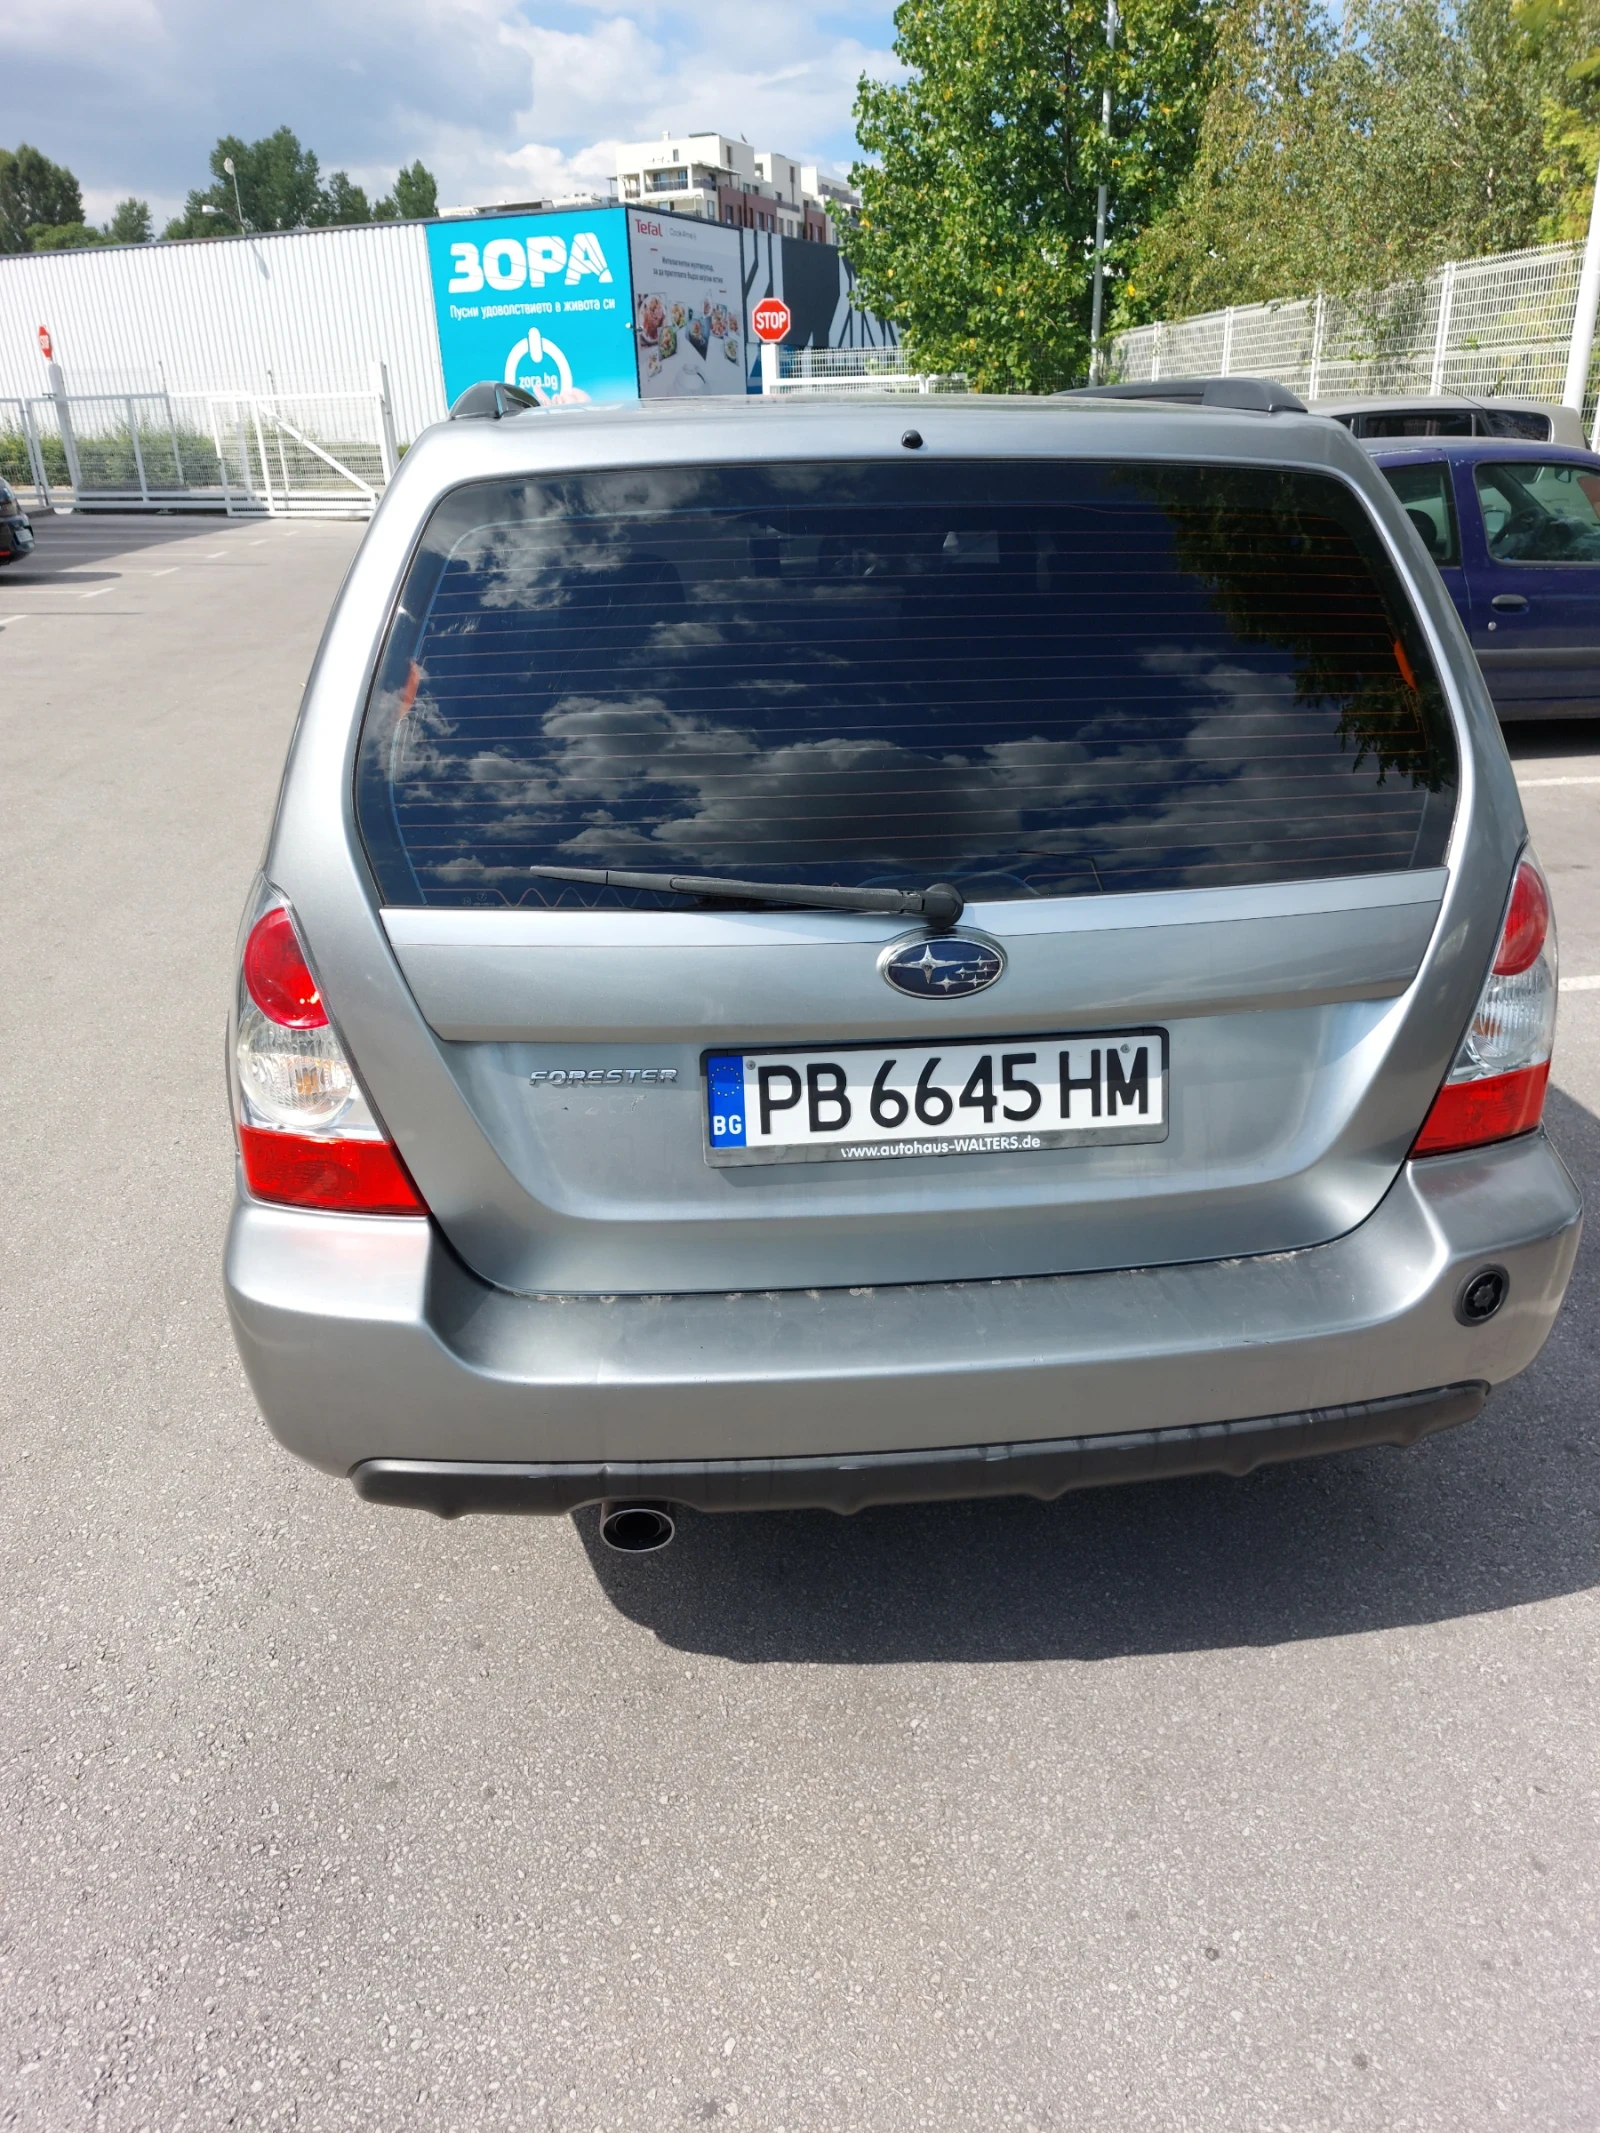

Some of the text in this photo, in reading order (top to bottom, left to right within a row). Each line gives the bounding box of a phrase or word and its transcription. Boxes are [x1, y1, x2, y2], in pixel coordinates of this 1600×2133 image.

[635, 219, 663, 237] Tefal
[448, 232, 613, 293] ЗОРА
[450, 298, 615, 321] Пусни удоволствието в живота си
[756, 311, 787, 329] STOP
[519, 372, 558, 390] zora.bg
[529, 1068, 679, 1086] FORESTER
[758, 1046, 1149, 1135] PB 6645 HM
[713, 1115, 742, 1136] BG
